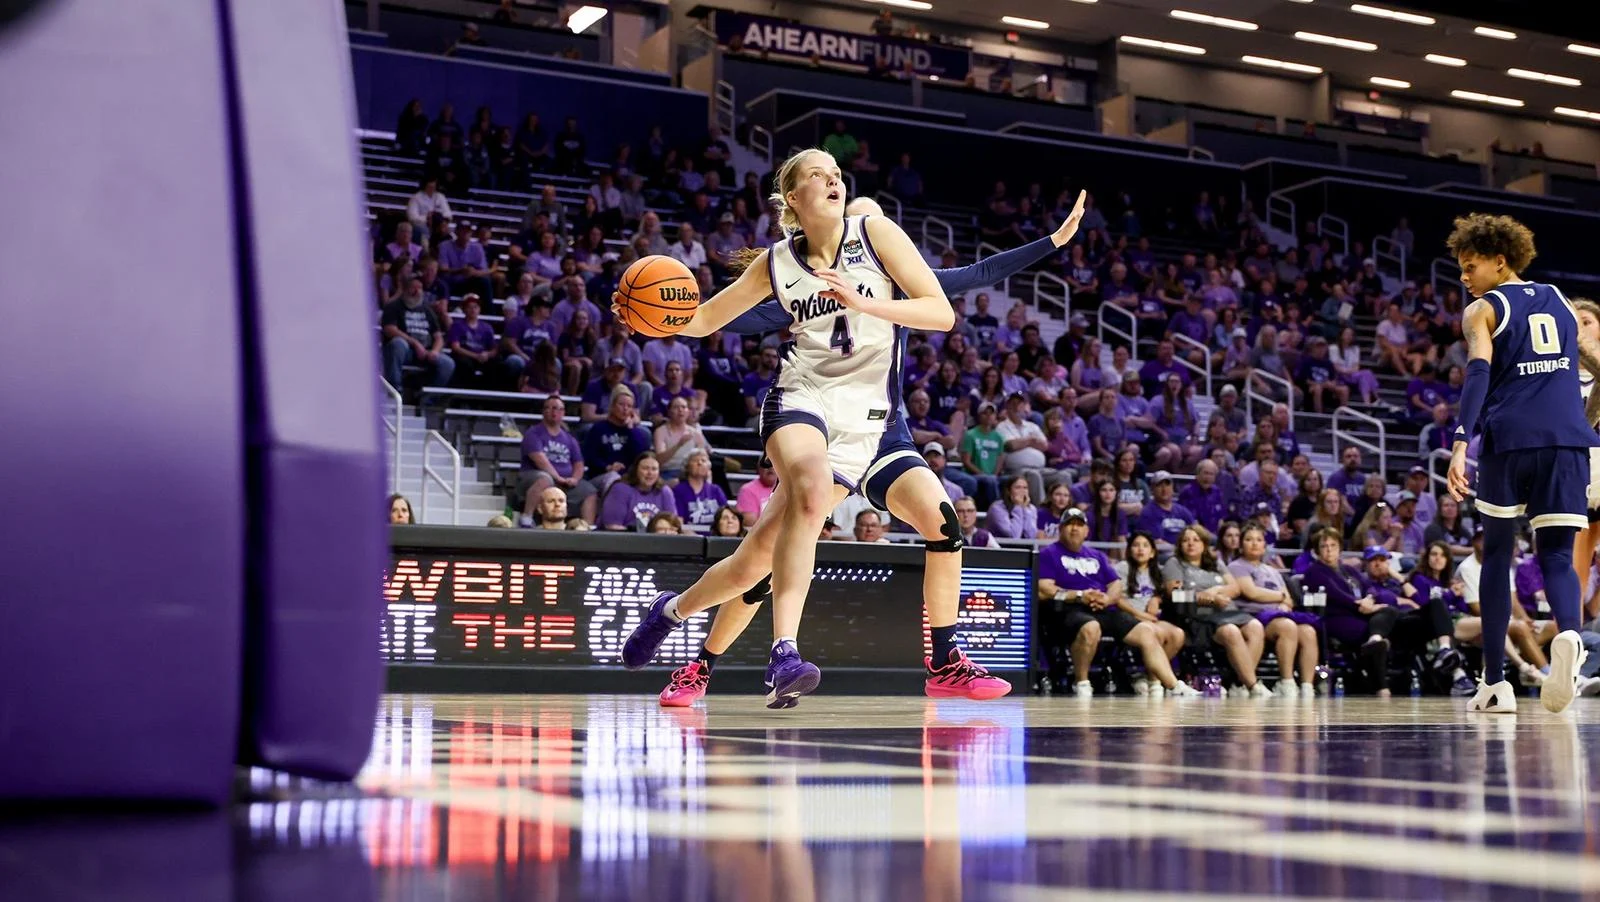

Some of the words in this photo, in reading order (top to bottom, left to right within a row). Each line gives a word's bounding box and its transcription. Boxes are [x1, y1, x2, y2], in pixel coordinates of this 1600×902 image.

[830, 315, 854, 357] 4
[1528, 313, 1562, 354] 0
[1517, 357, 1570, 375] TURNAGE
[383, 560, 575, 604] WBIT
[583, 566, 658, 607] 2026
[452, 613, 576, 649] THE
